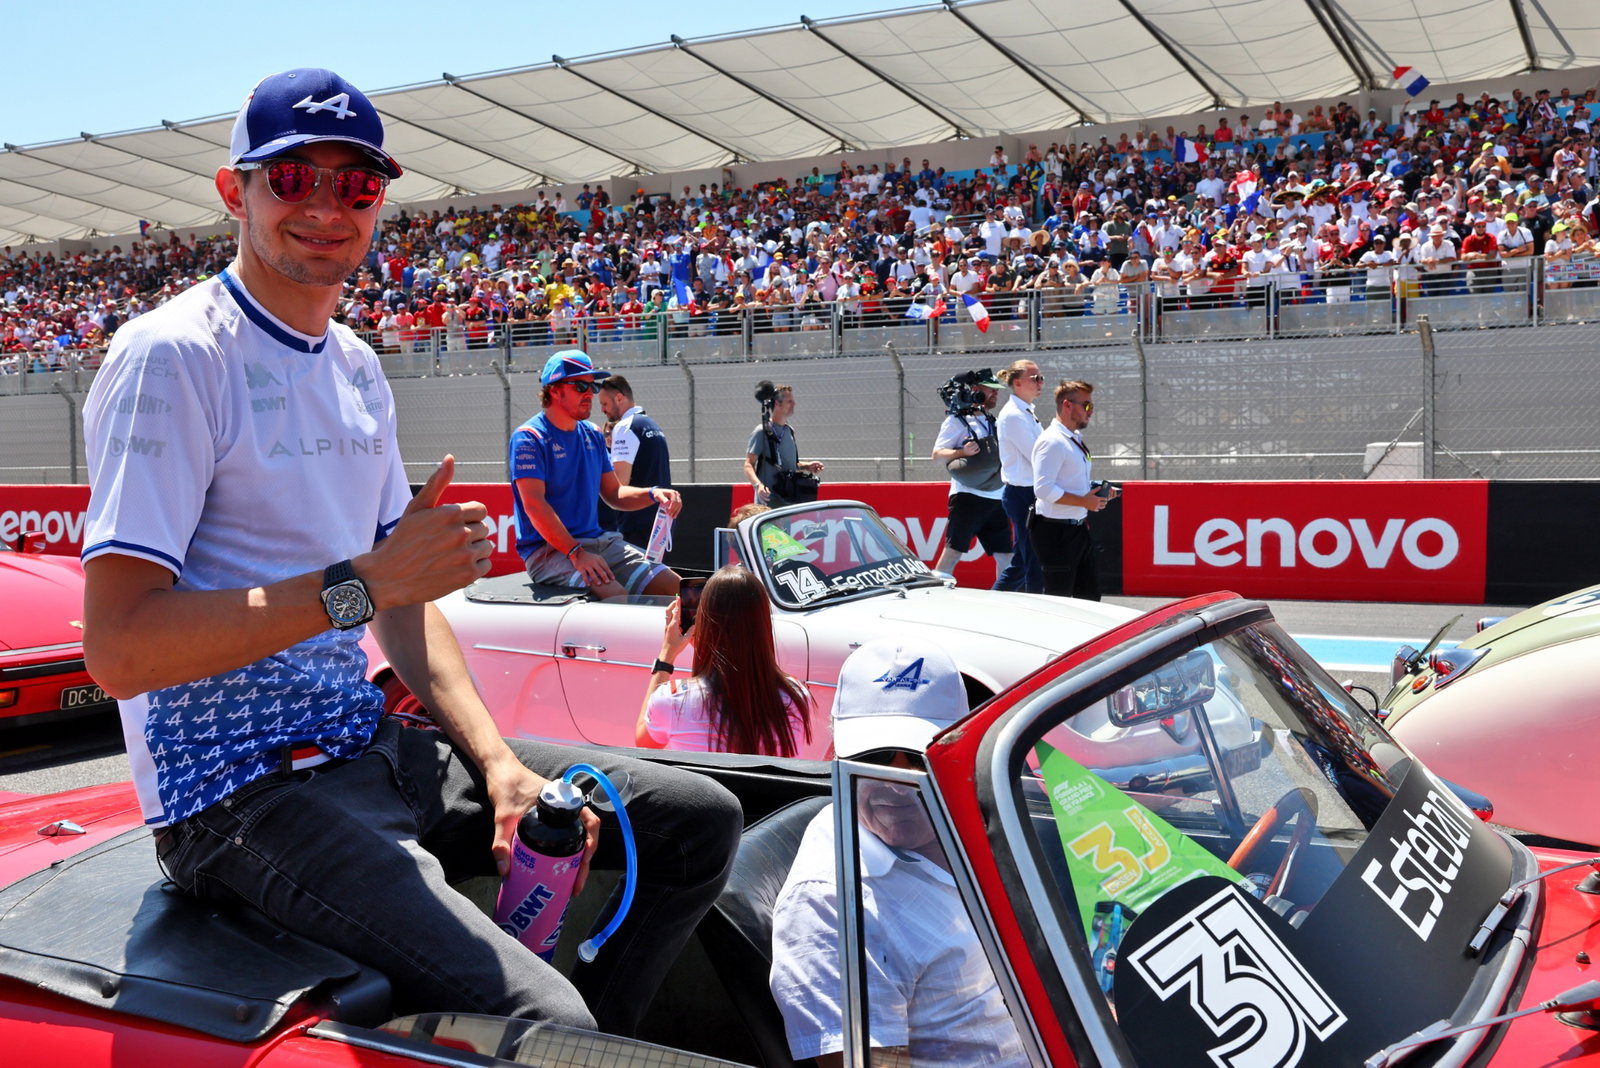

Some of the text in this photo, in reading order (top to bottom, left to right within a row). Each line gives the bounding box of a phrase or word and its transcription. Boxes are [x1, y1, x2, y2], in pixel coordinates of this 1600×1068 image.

[268, 438, 383, 458] ALPINE
[1, 510, 86, 543] enov
[1153, 505, 1459, 570] Lenovo
[775, 566, 829, 600] 14
[830, 561, 904, 590] Fernando
[1361, 790, 1473, 942] Esteban
[508, 882, 556, 932] BWT
[1127, 884, 1349, 1068] 31
